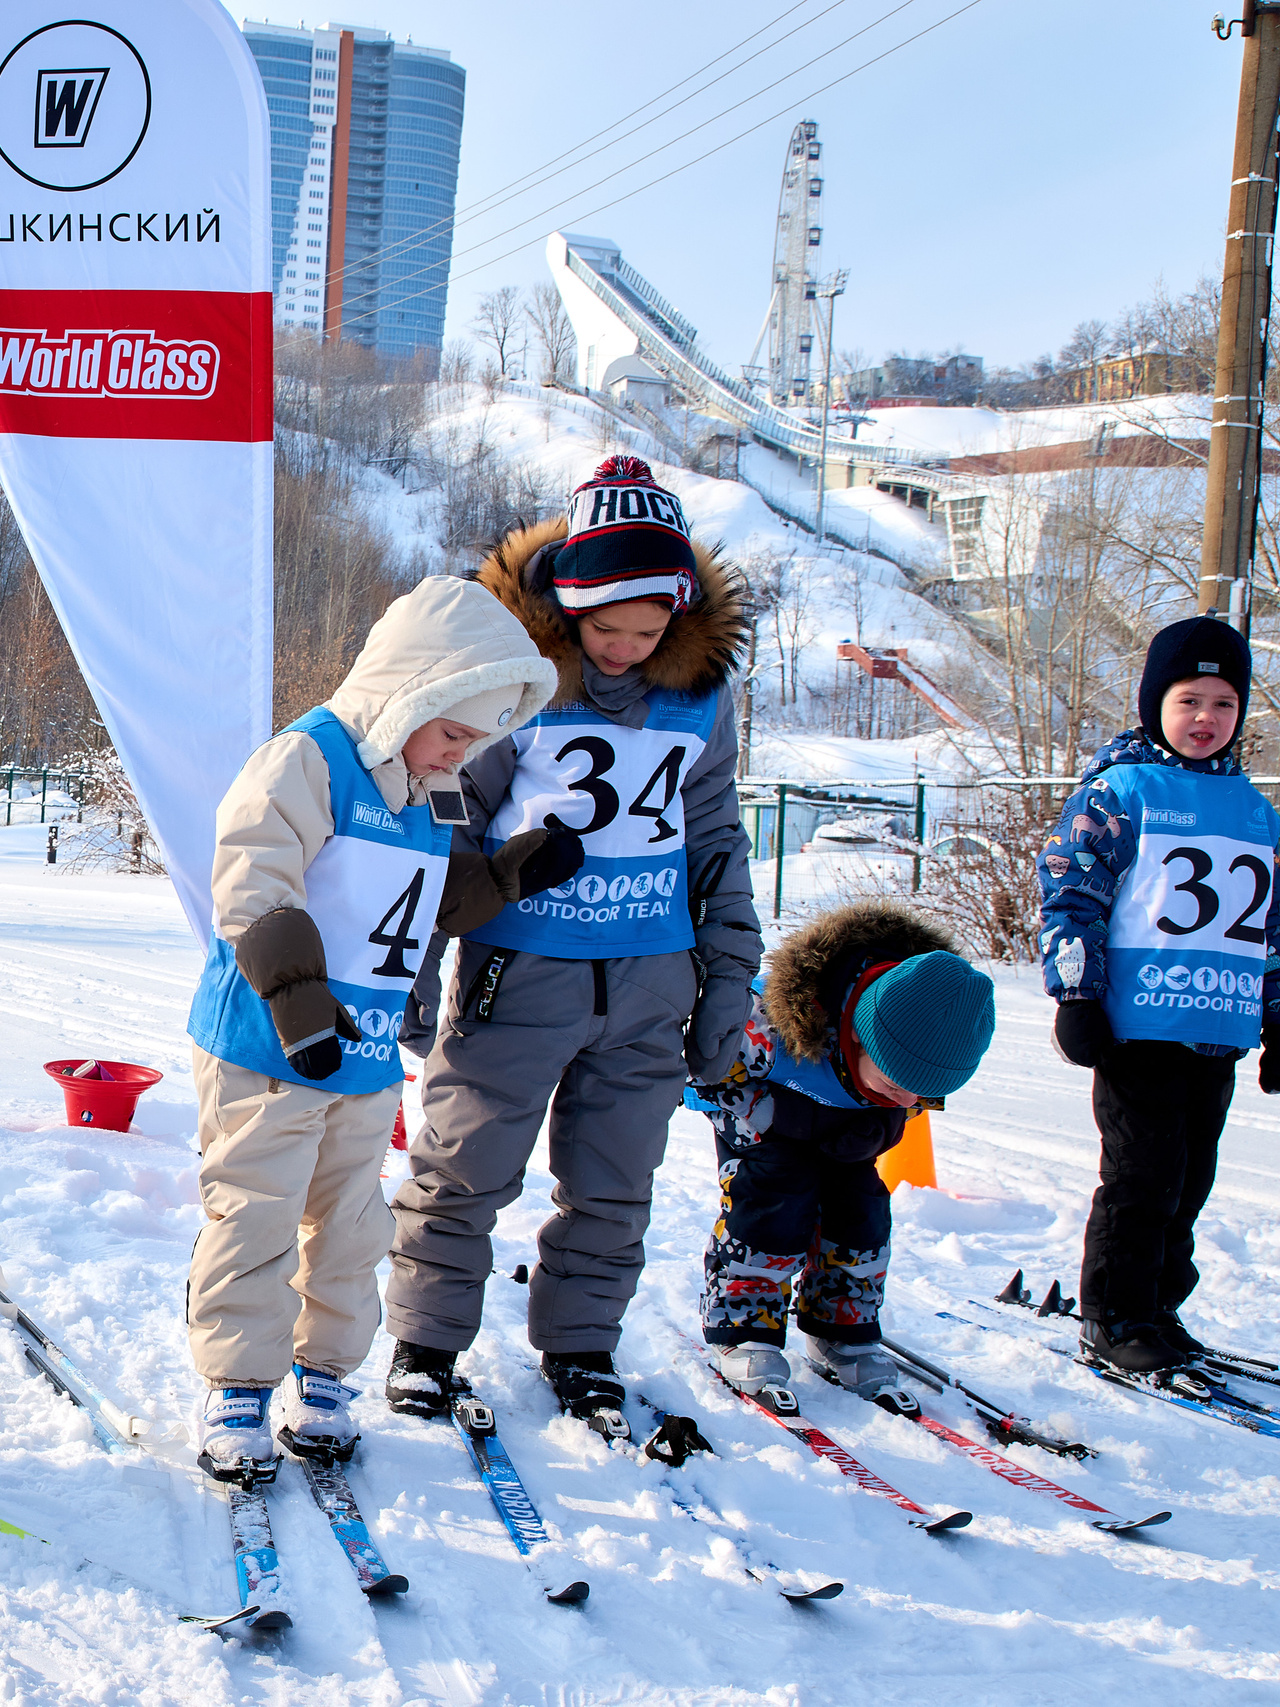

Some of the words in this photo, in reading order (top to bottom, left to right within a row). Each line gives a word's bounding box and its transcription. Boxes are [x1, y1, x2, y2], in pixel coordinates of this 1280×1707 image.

[44, 79, 95, 138] W
[108, 338, 210, 391] Class
[355, 804, 382, 826] World
[543, 735, 687, 844] 34
[1143, 808, 1168, 822] World
[1169, 811, 1194, 825] Class
[517, 897, 621, 923] OUTDOOR
[1155, 846, 1271, 946] 32
[368, 867, 425, 980] 4
[1133, 992, 1233, 1013] OUTDOOR
[1236, 999, 1261, 1017] TEAM
